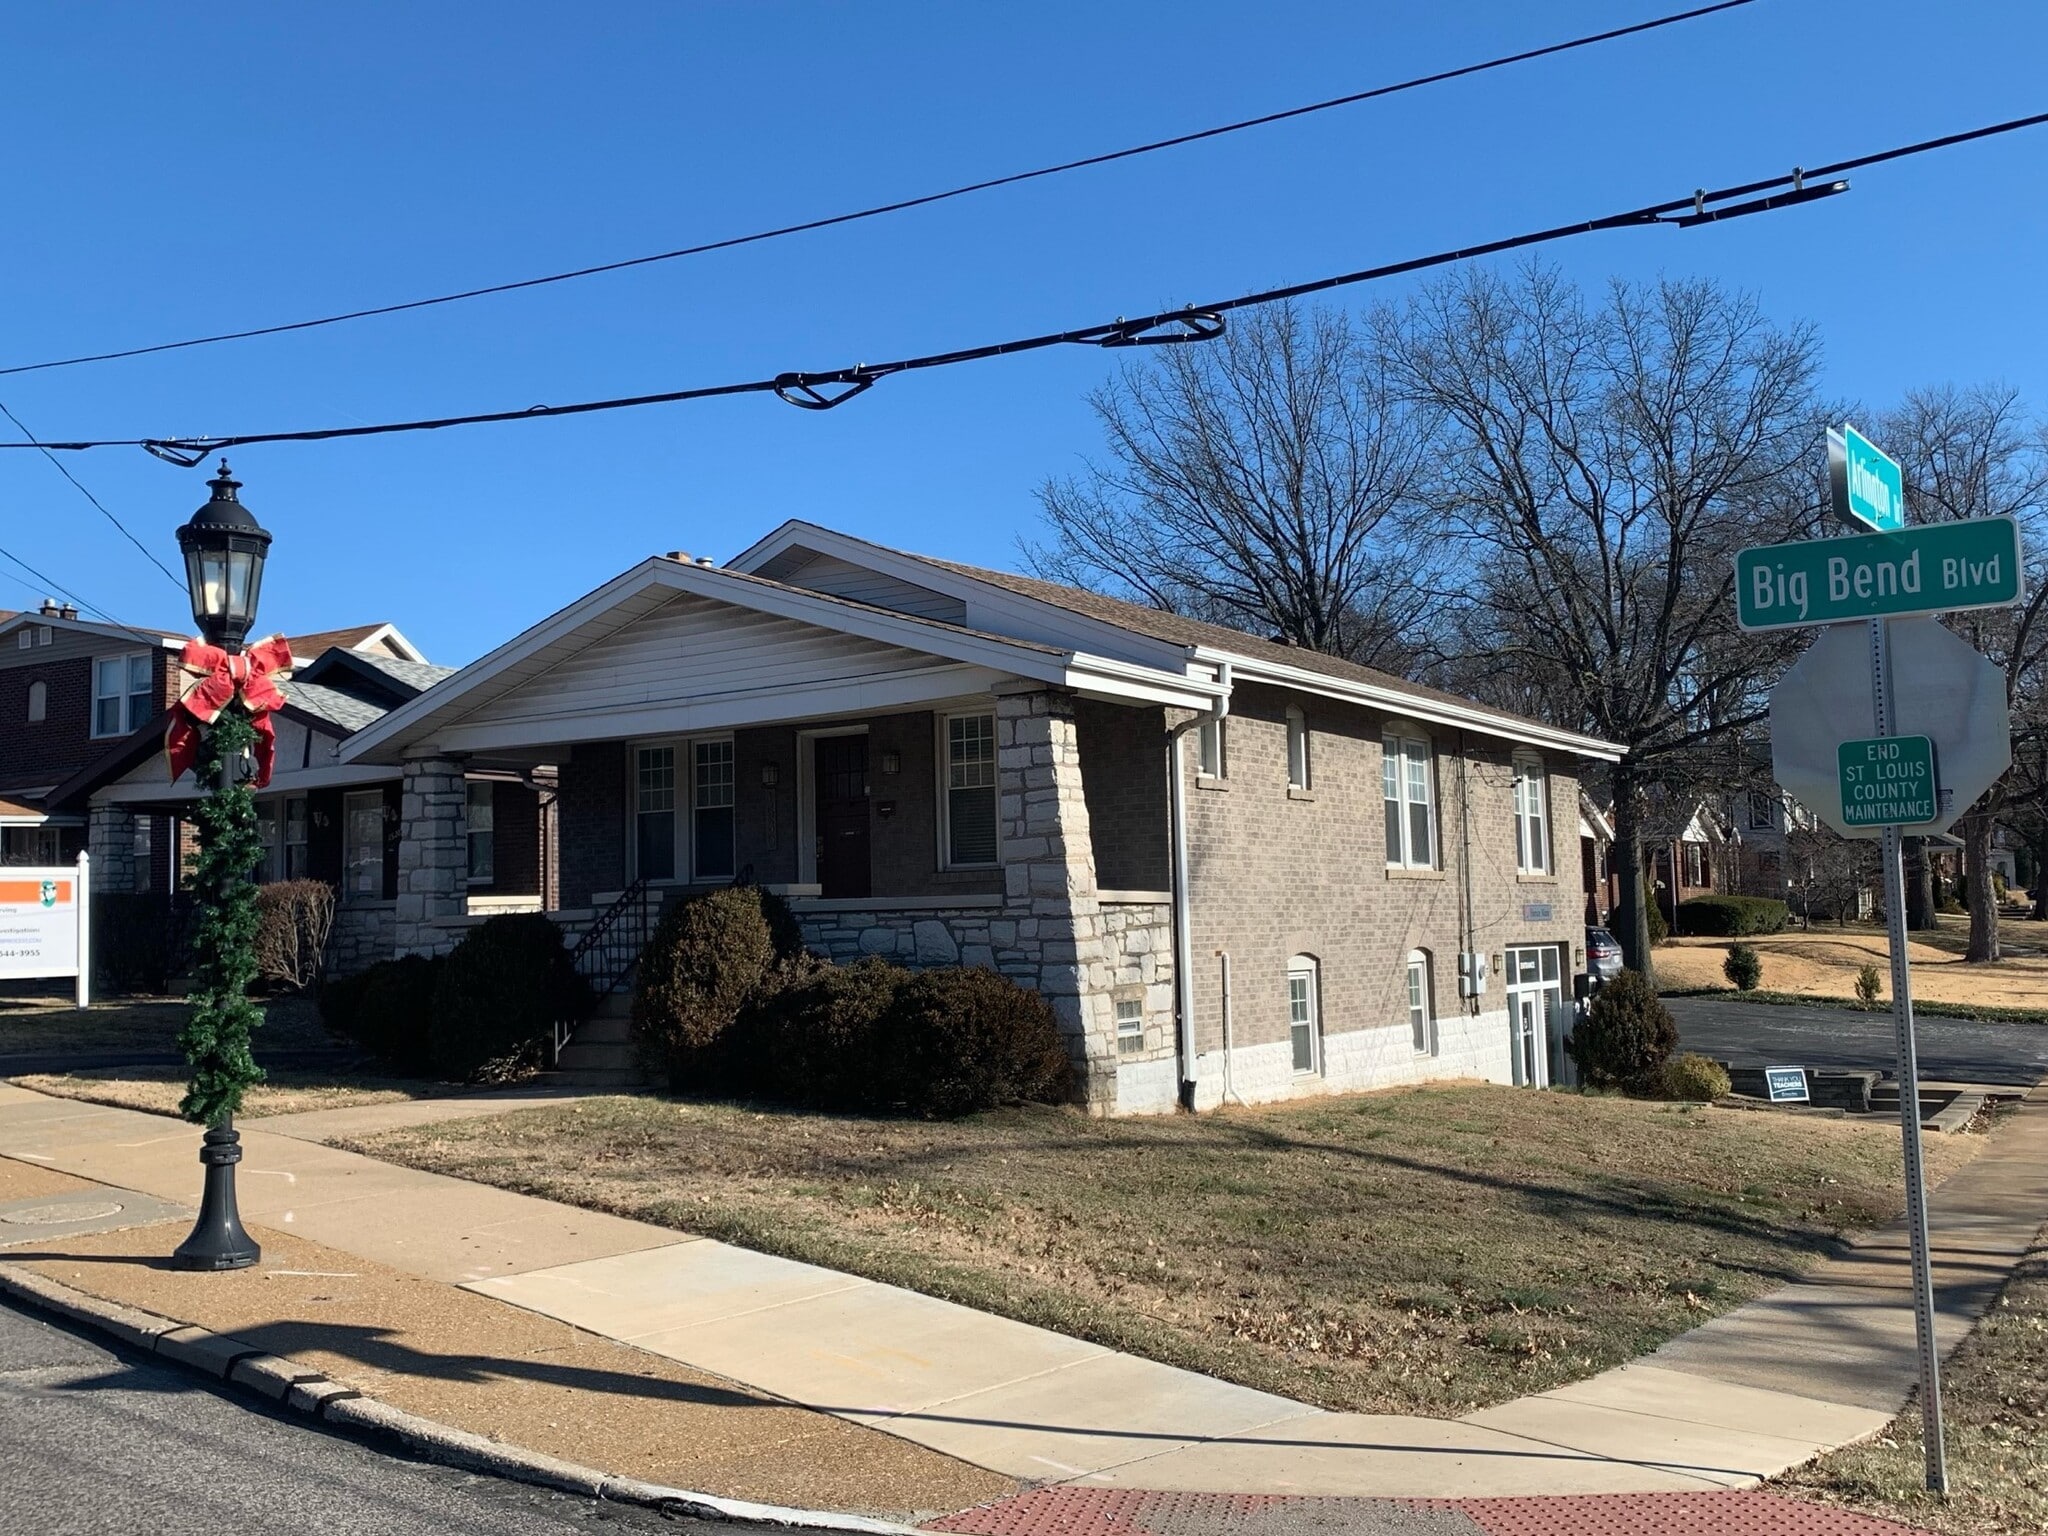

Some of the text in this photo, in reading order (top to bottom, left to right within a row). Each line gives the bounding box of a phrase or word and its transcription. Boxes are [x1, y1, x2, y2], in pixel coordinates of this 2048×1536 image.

[1851, 449, 1891, 525] Arlington
[1753, 548, 2001, 620] Big Bend Blvd
[1867, 744, 1900, 761] END
[1846, 761, 1925, 782] ST LOUIS
[1854, 781, 1919, 801] COUNTY
[1845, 800, 1932, 821] MAINTENANCE
